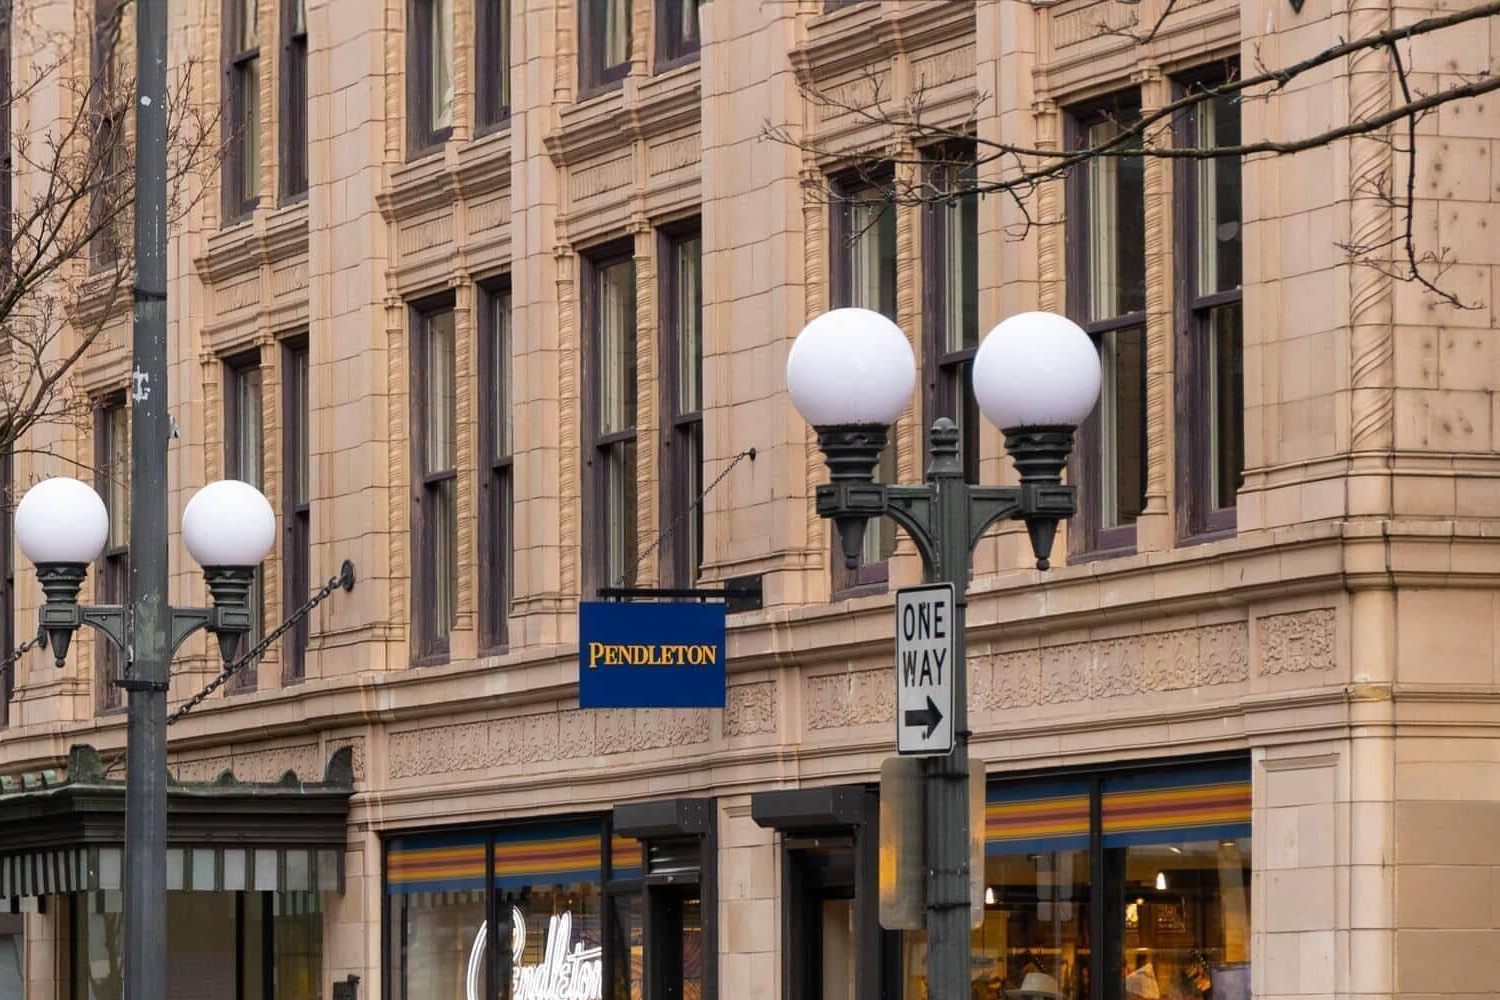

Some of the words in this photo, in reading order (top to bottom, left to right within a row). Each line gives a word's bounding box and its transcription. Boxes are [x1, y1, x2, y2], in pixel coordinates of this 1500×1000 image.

[903, 601, 946, 641] ONE
[588, 642, 717, 668] PENDLETON
[903, 648, 946, 688] WAY
